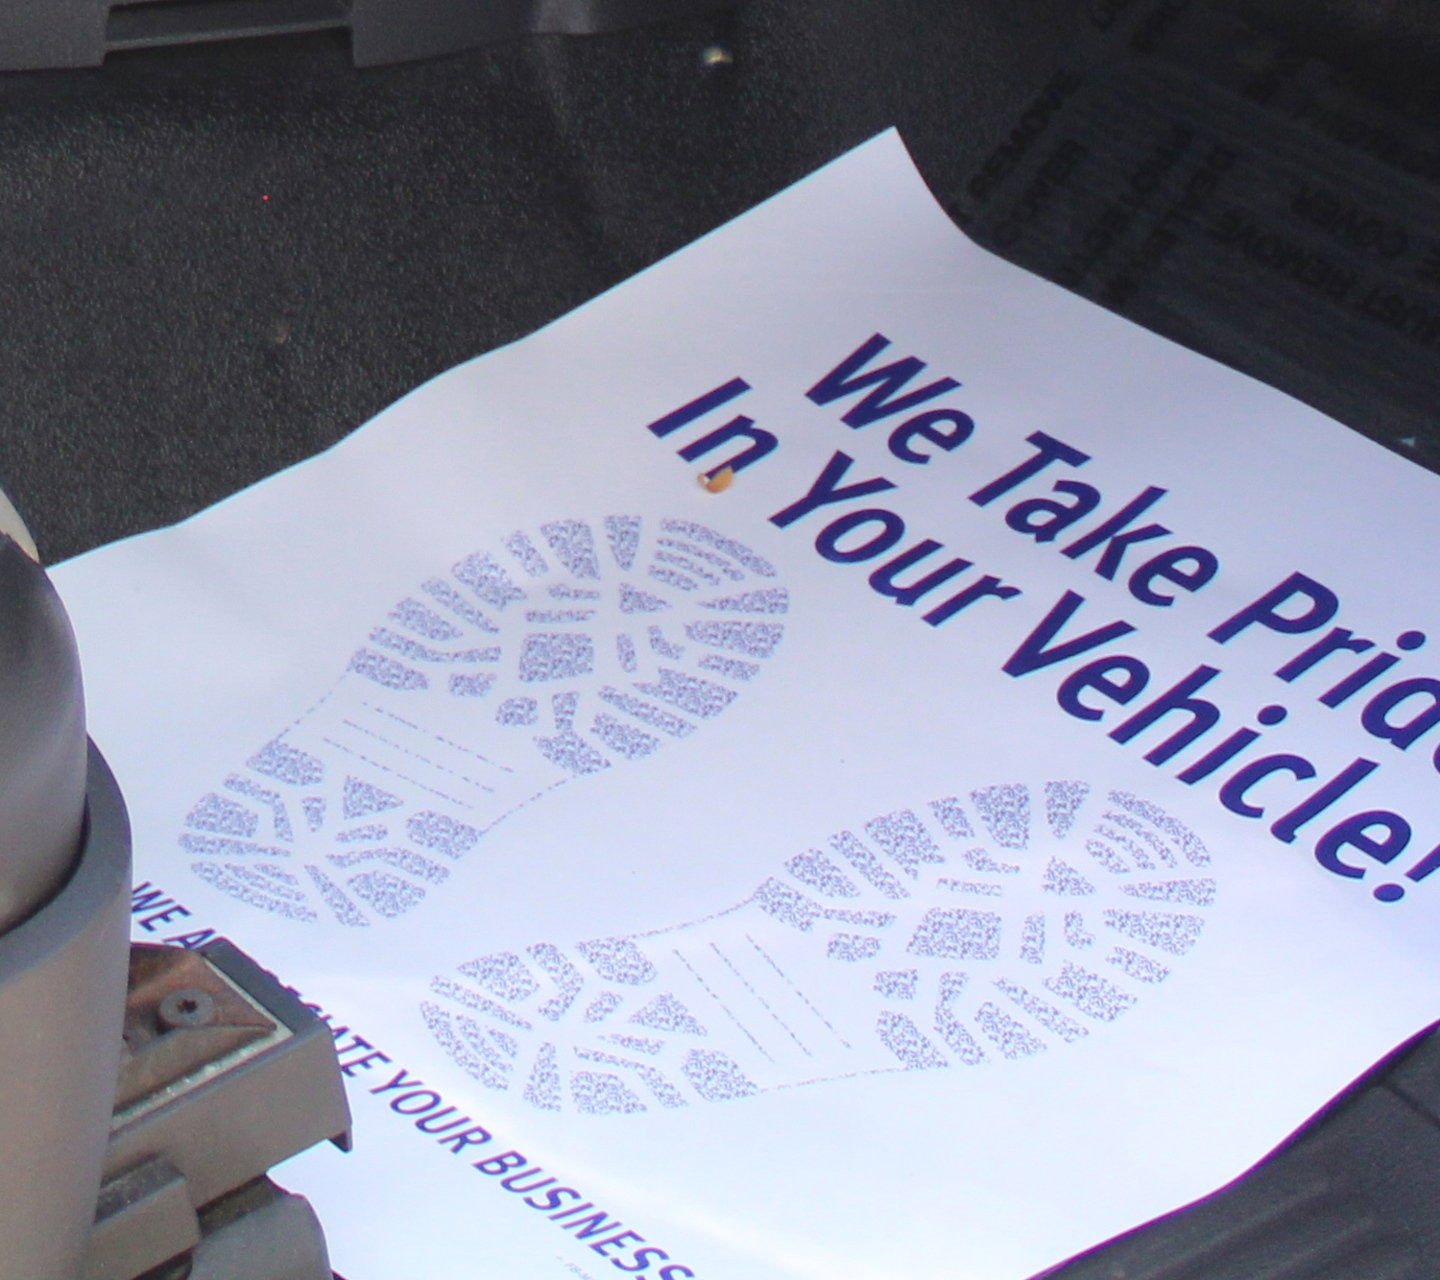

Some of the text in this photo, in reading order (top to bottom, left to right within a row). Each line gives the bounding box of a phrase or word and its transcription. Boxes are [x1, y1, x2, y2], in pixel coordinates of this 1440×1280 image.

[646, 376, 779, 480] In
[768, 449, 1023, 627] Your
[803, 332, 975, 464] We
[967, 430, 1219, 607] Take
[368, 1069, 493, 1154] YOUR
